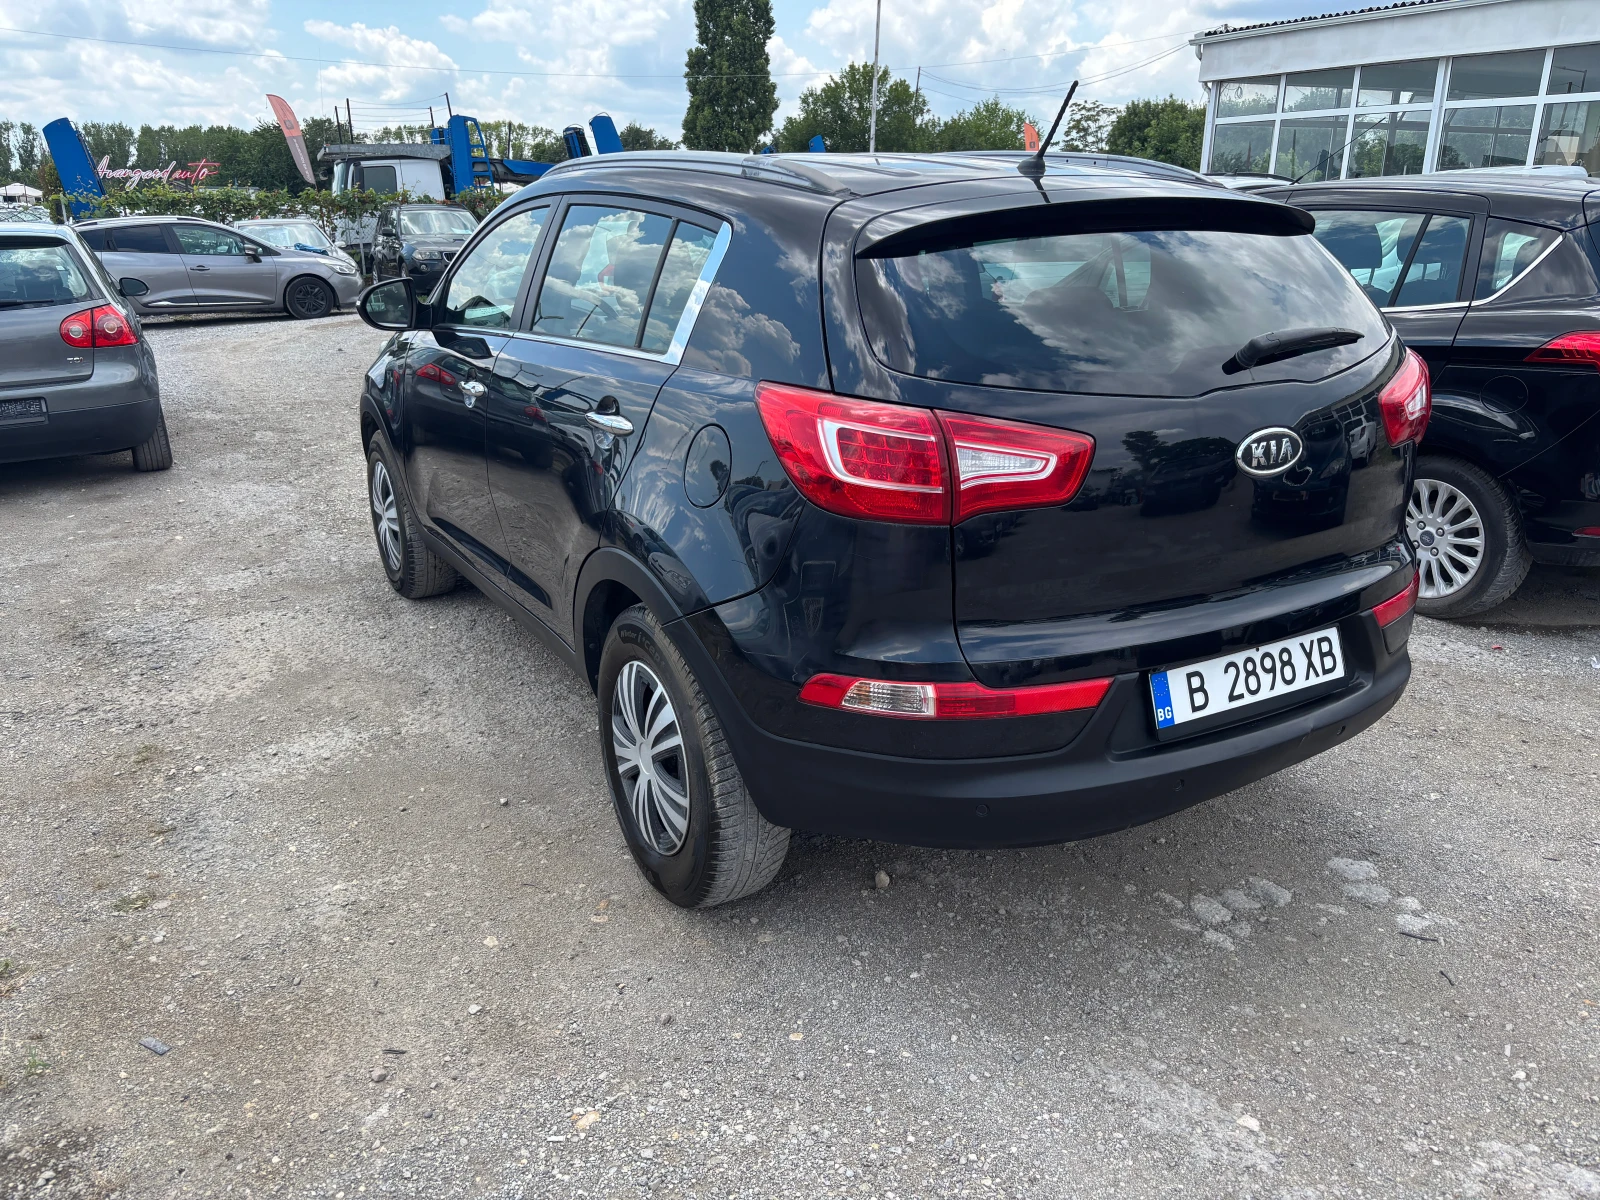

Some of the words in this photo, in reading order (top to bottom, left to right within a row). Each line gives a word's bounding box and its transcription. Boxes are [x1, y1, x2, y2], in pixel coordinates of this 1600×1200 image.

[97, 155, 176, 191] Avangard
[172, 158, 221, 185] auto
[1250, 437, 1293, 467] KIA
[1157, 706, 1173, 722] BG
[1186, 670, 1210, 713] B
[1223, 647, 1297, 703] 2898
[1299, 636, 1338, 681] XB
